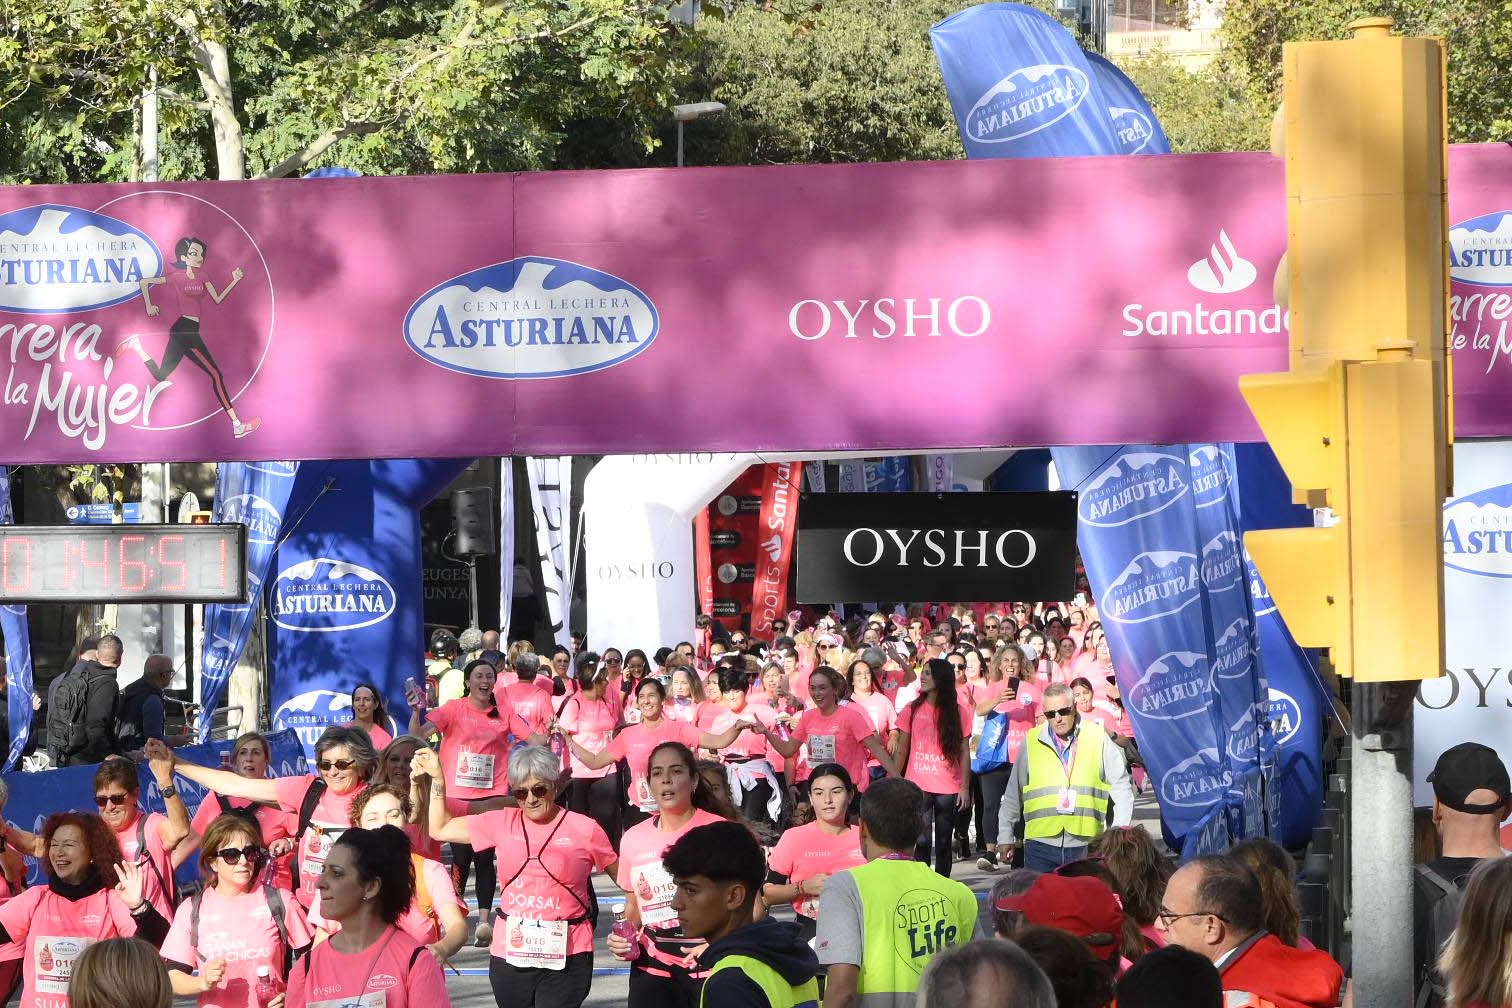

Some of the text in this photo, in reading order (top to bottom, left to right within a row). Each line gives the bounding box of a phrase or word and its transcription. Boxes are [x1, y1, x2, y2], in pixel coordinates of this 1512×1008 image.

[462, 297, 630, 313] CENTRAL LECHERA
[788, 295, 992, 341] OYSHO
[1122, 303, 1289, 337] Santand
[423, 305, 640, 349] ASTURIANA
[4, 367, 28, 405] la
[24, 358, 174, 450] Mujer
[843, 527, 1037, 569] OYSHO
[274, 590, 387, 617] ASTURIANA
[334, 582, 382, 592] LECHERA
[1416, 668, 1512, 710] OY
[508, 895, 561, 910] DORSAL
[897, 896, 948, 930] Sport
[907, 919, 957, 959] Life
[313, 983, 342, 996] OYSHO
